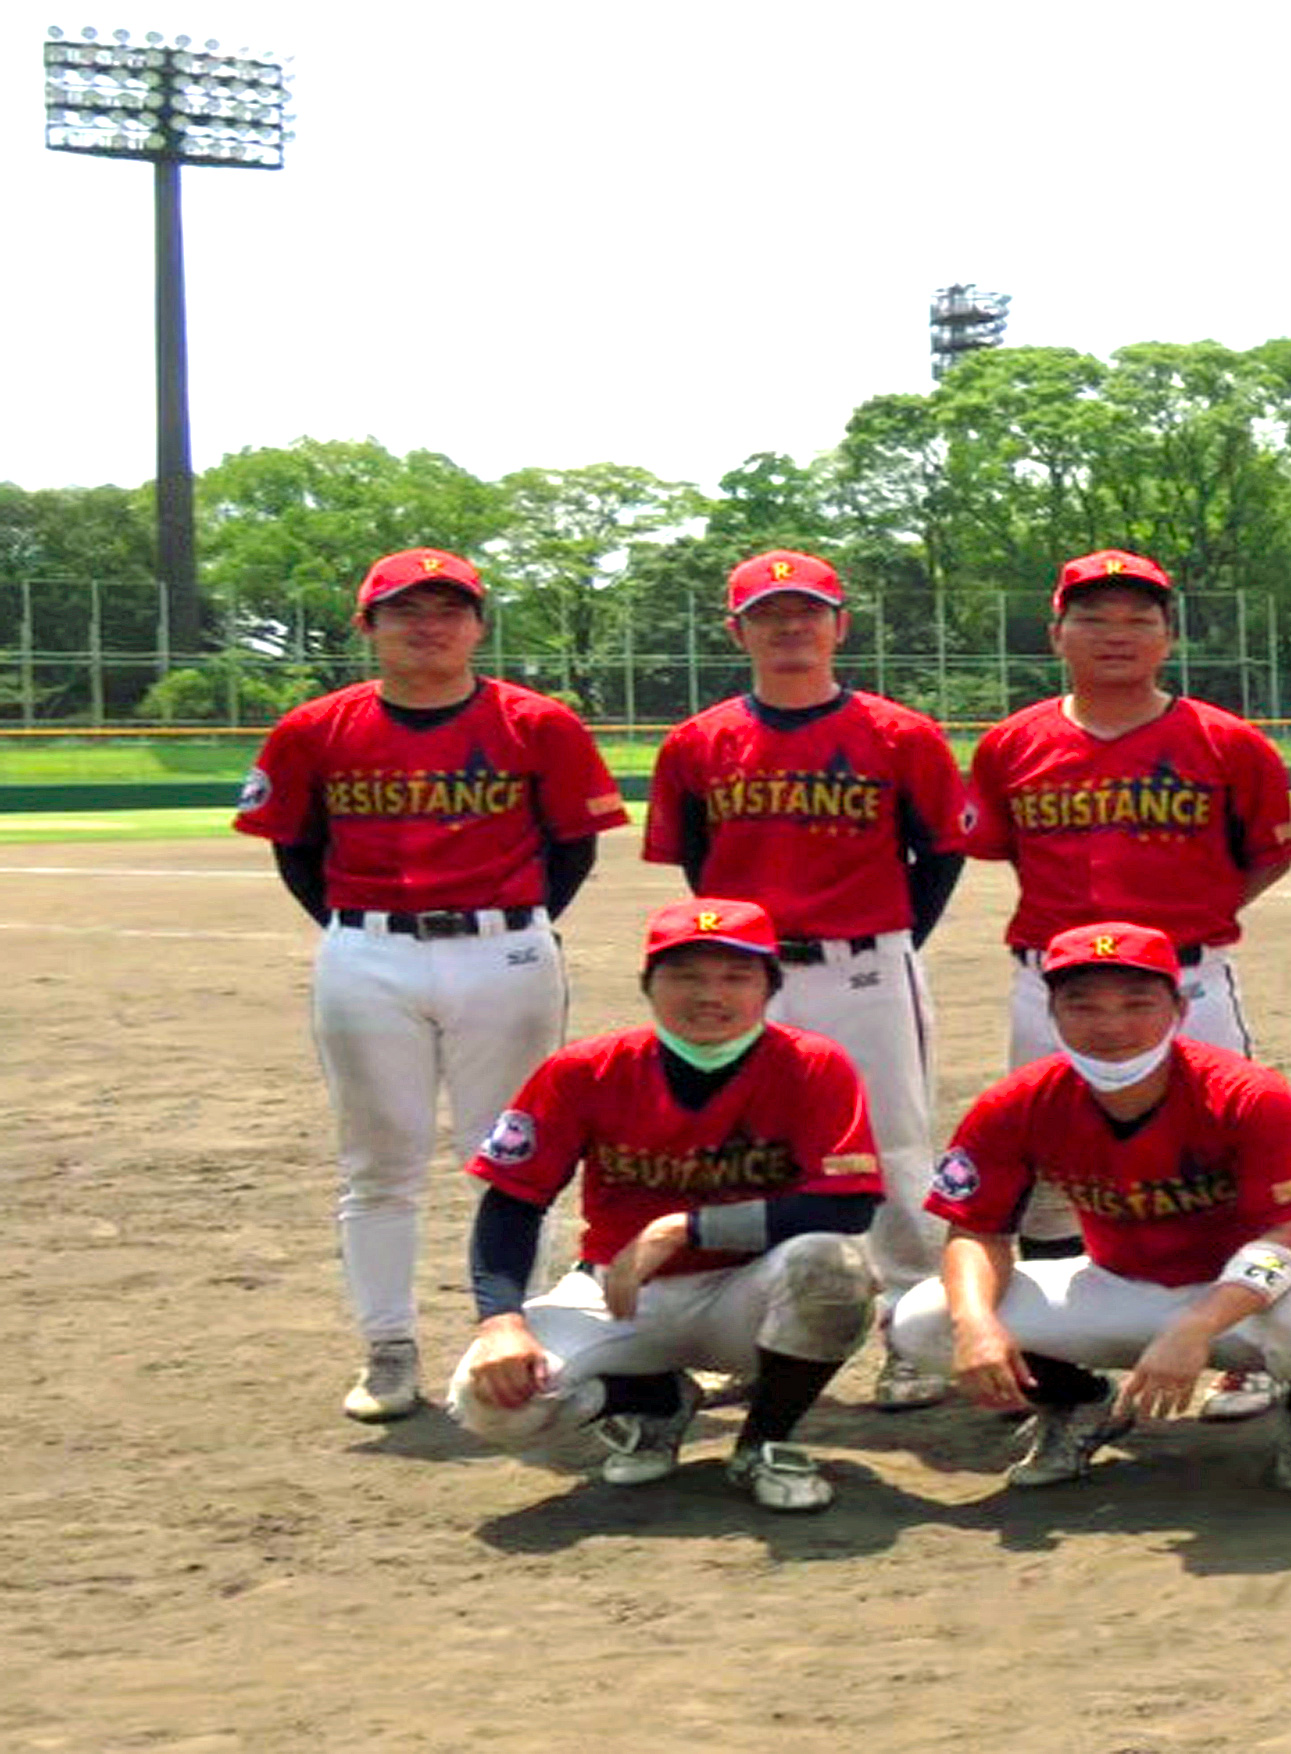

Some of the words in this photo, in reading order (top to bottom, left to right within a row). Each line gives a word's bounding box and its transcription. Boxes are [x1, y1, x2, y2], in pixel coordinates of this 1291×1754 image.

[421, 556, 442, 573] R
[772, 561, 792, 582] R
[1106, 558, 1124, 575] R
[697, 906, 722, 931] R
[1094, 934, 1115, 956] R
